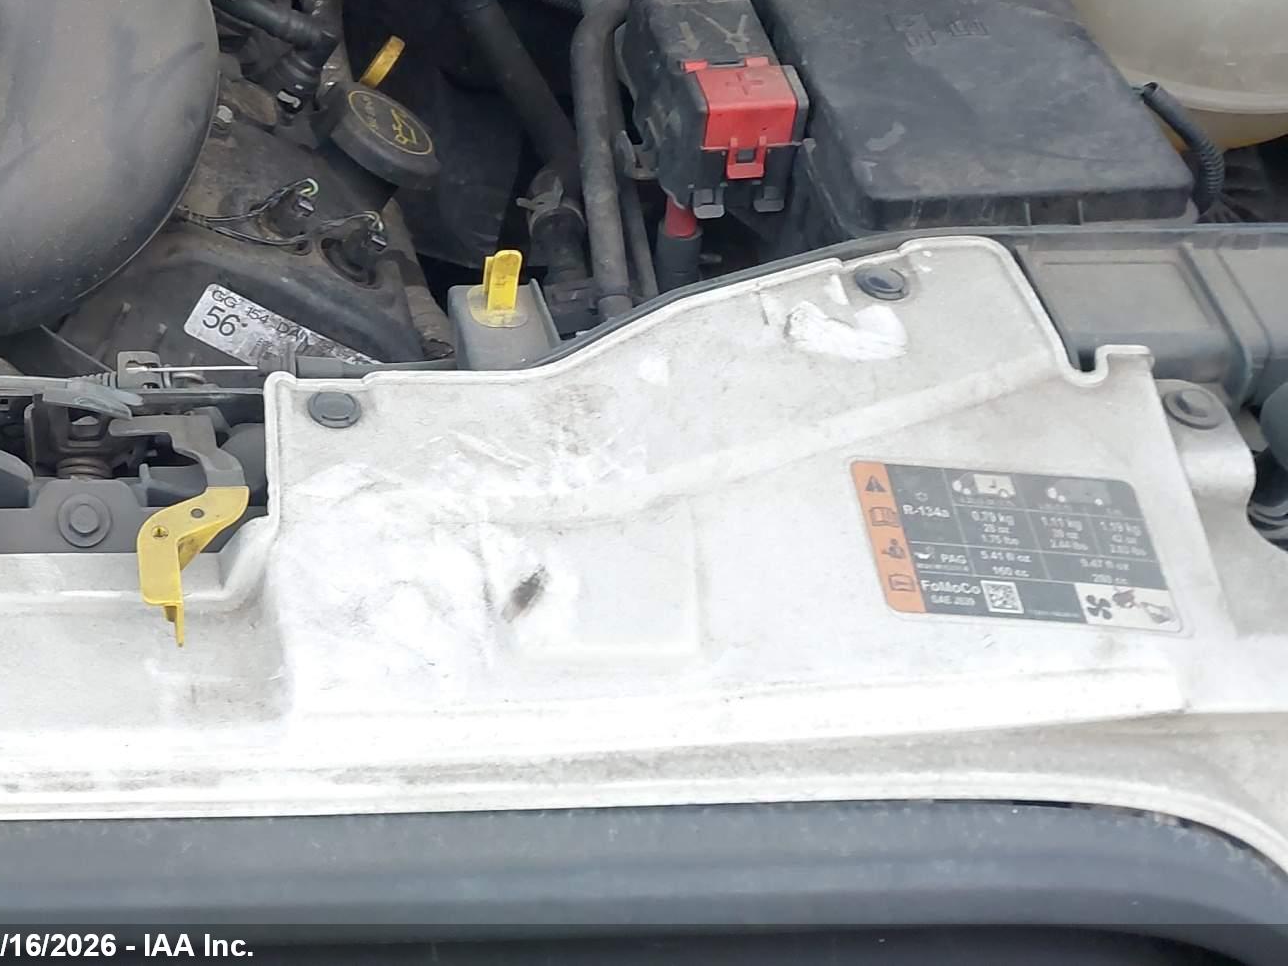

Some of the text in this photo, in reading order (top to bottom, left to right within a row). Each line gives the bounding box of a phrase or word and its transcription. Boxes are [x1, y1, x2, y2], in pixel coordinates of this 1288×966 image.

[210, 287, 238, 309] GG
[244, 305, 269, 324] 154
[200, 302, 241, 339] 56
[902, 504, 950, 518] R-134a
[997, 512, 1015, 526] kg
[939, 553, 967, 564] PAG
[919, 578, 981, 595] FoMoCo
[930, 594, 952, 605] SAE
